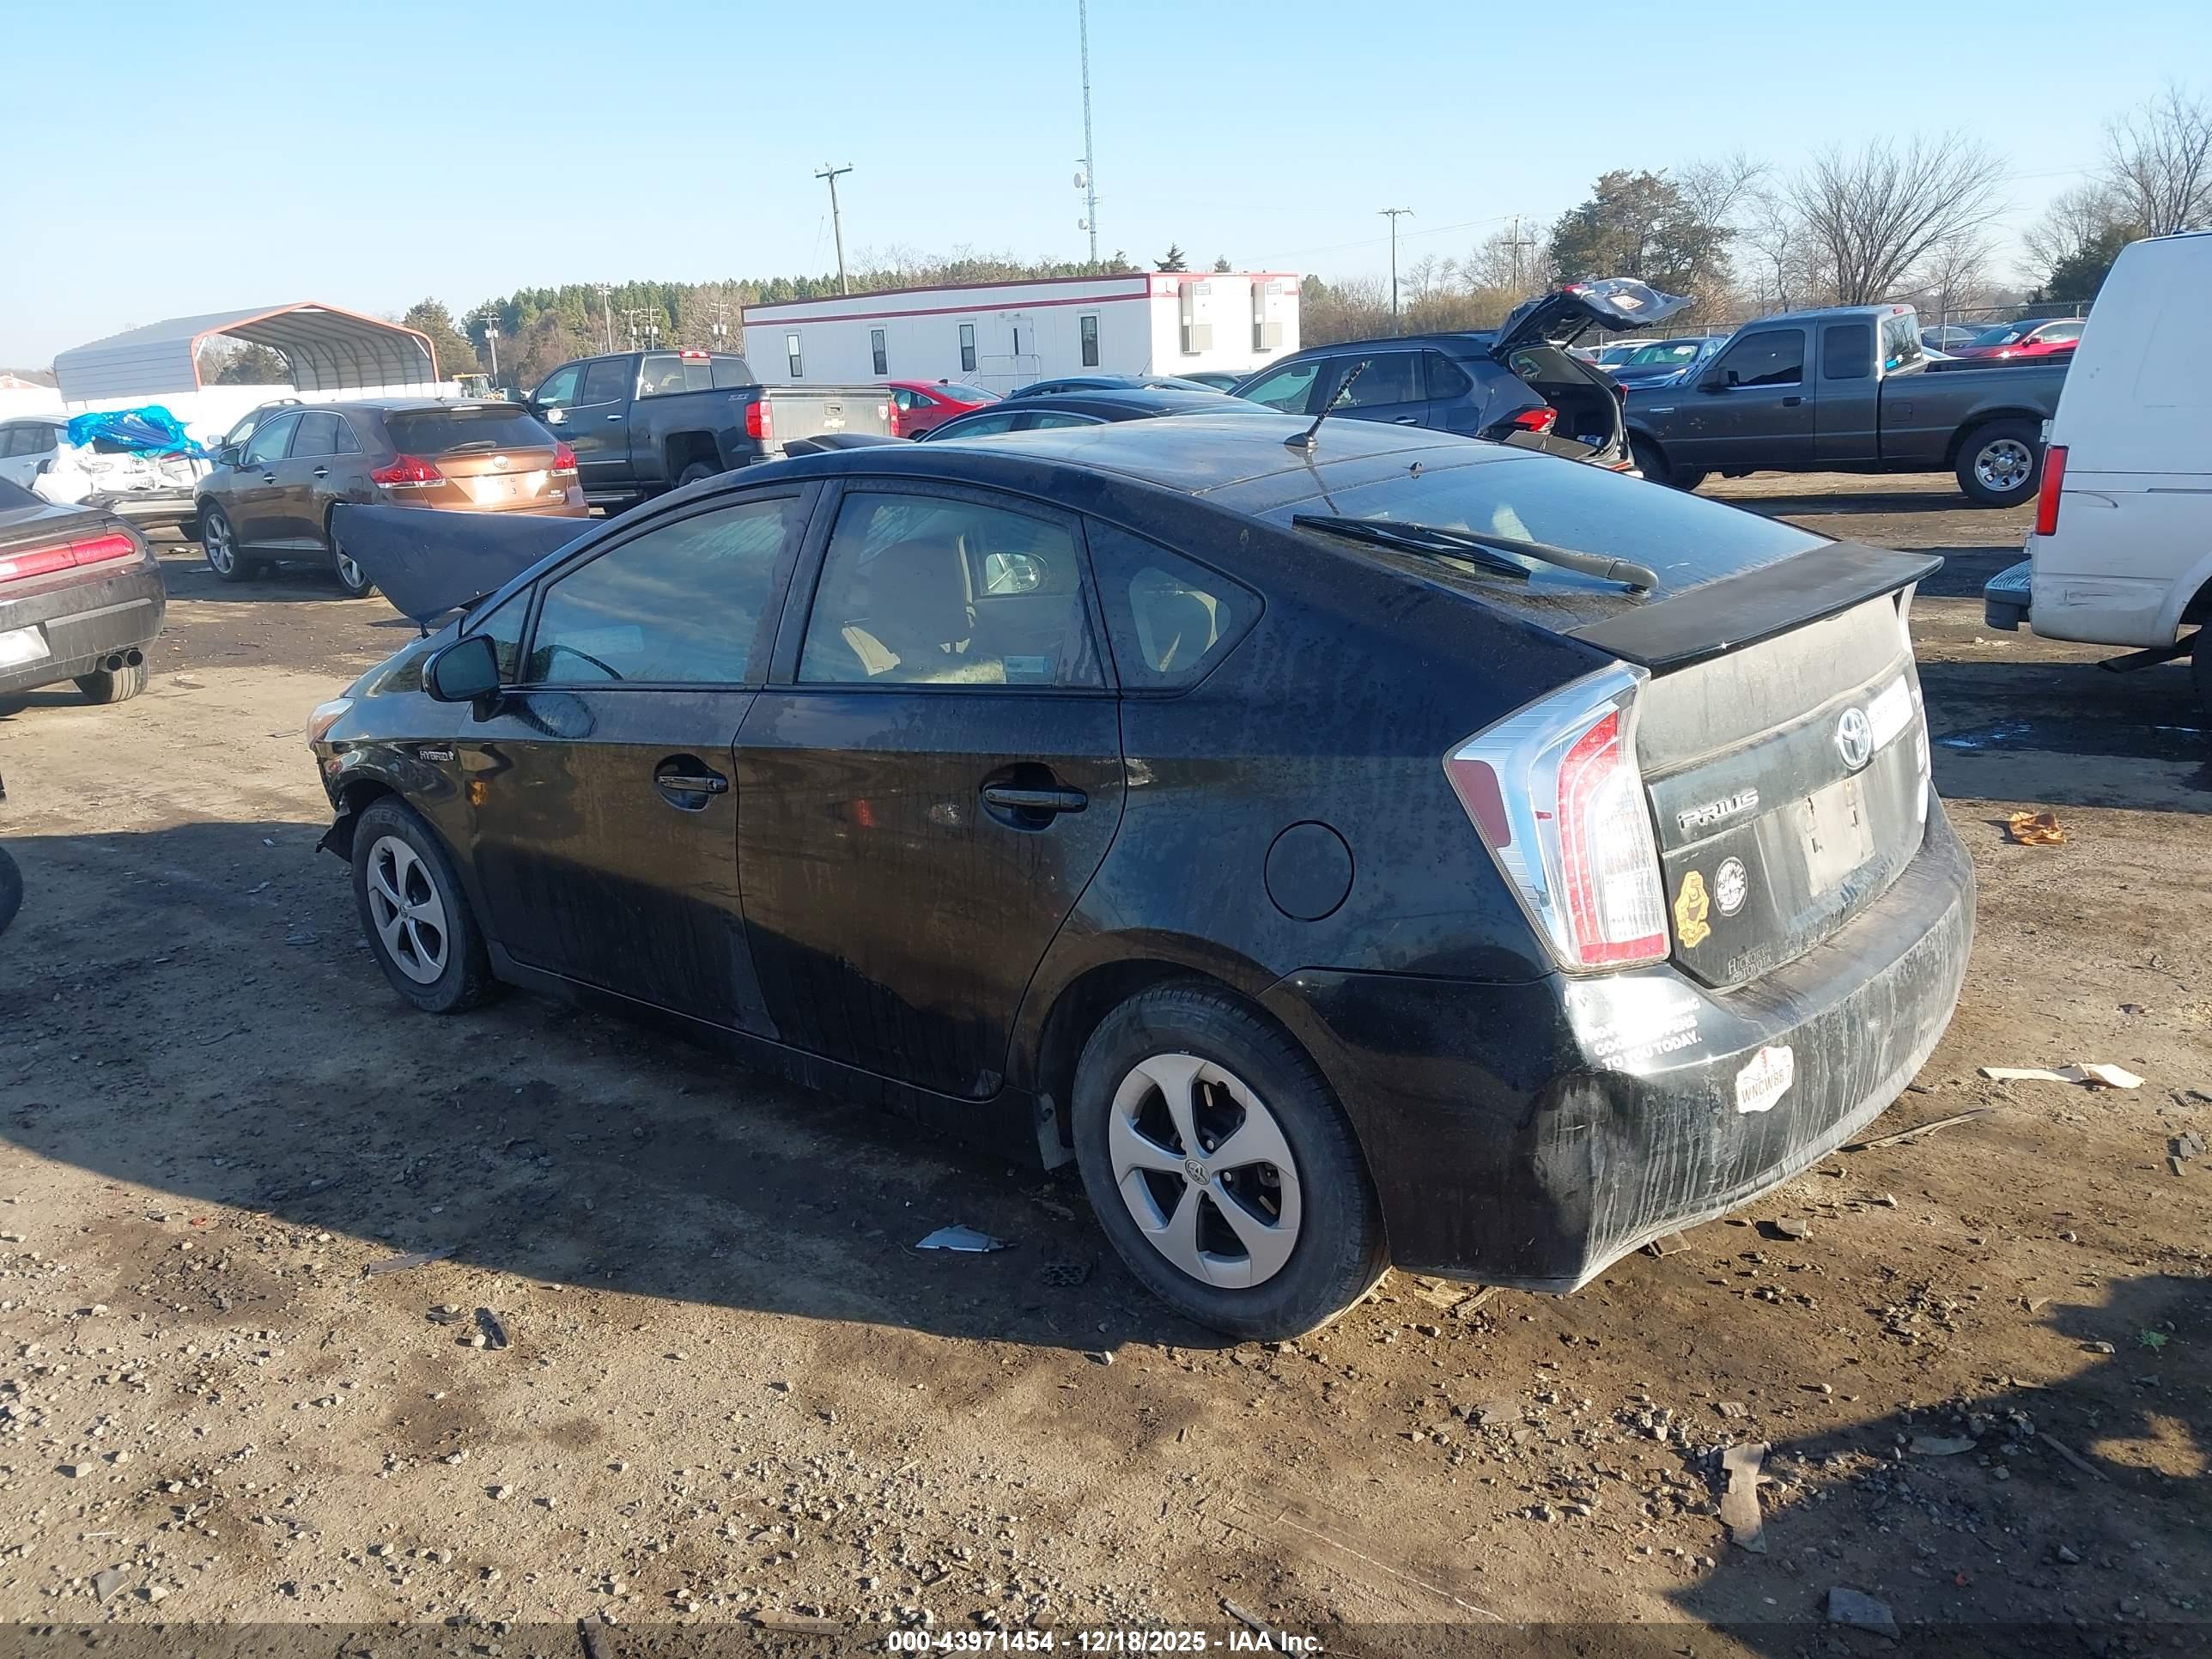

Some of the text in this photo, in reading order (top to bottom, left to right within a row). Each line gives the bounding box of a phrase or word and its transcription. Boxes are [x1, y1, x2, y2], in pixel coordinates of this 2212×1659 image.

[1677, 788, 1759, 830] PRIUS
[1602, 1050, 1624, 1071] TO
[1653, 1030, 1703, 1055] TODAY.
